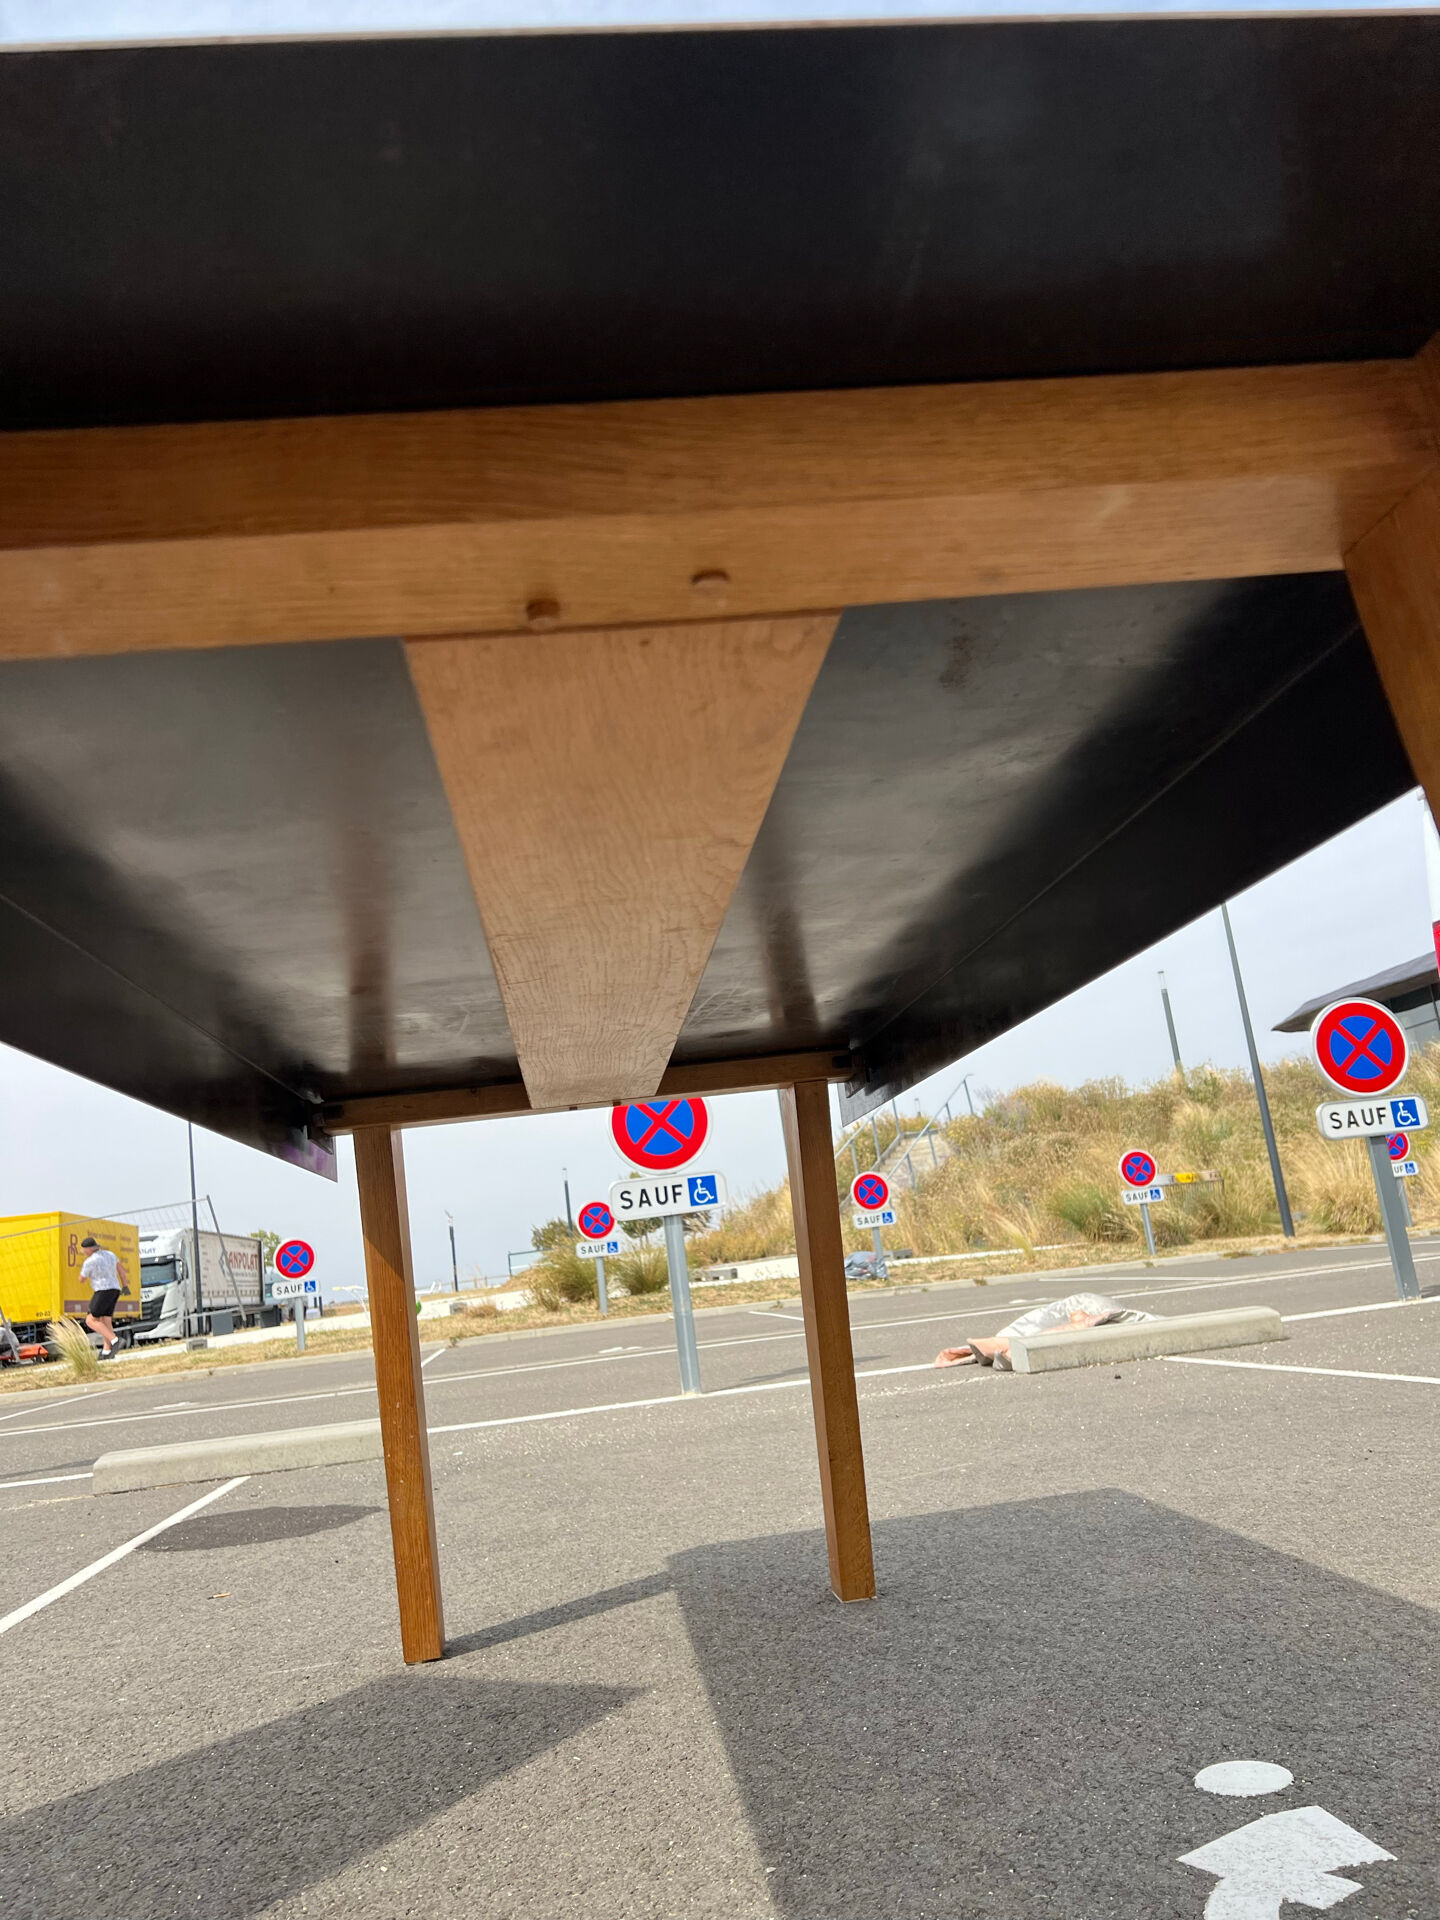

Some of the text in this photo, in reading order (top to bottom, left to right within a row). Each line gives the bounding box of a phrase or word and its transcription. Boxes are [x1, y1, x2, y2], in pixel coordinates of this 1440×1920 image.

[1329, 1107, 1387, 1130] SAUF
[620, 1184, 683, 1210] SAUF
[1125, 1191, 1149, 1202] SAUF
[857, 1214, 881, 1226] SAUF
[580, 1244, 606, 1255] SAUF
[276, 1283, 304, 1296] SAUF
